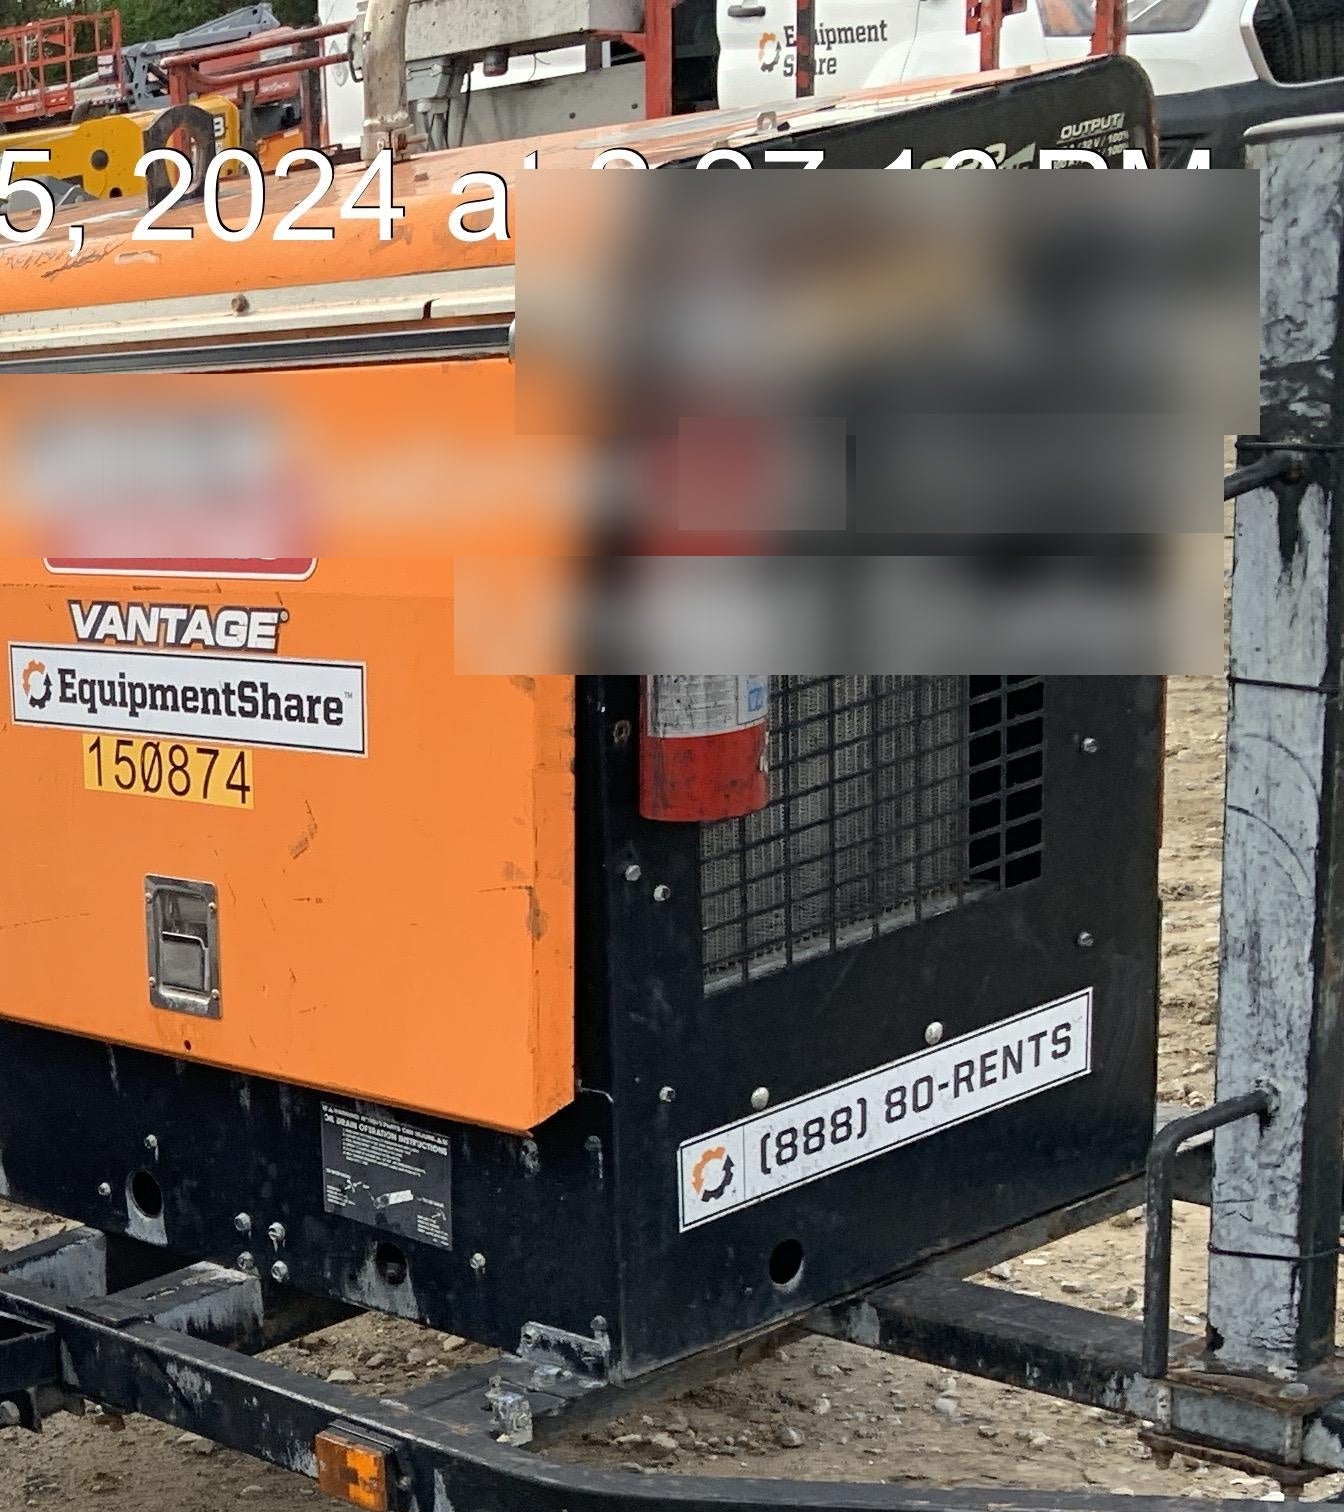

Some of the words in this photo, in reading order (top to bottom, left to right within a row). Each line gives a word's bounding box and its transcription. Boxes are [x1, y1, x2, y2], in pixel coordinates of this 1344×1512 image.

[783, 19, 888, 50] Eipment
[782, 54, 837, 77] Sre
[1059, 112, 1121, 139] OUTPUT
[70, 601, 280, 651] VANTAGE
[58, 666, 344, 727] EquipmentShare
[88, 734, 251, 805] 150874
[759, 1097, 868, 1175] (888)
[884, 1021, 1073, 1123] 80-RENTS
[358, 1123, 397, 1141] OPERATION
[398, 1134, 448, 1157] INSTRUCTIONS
